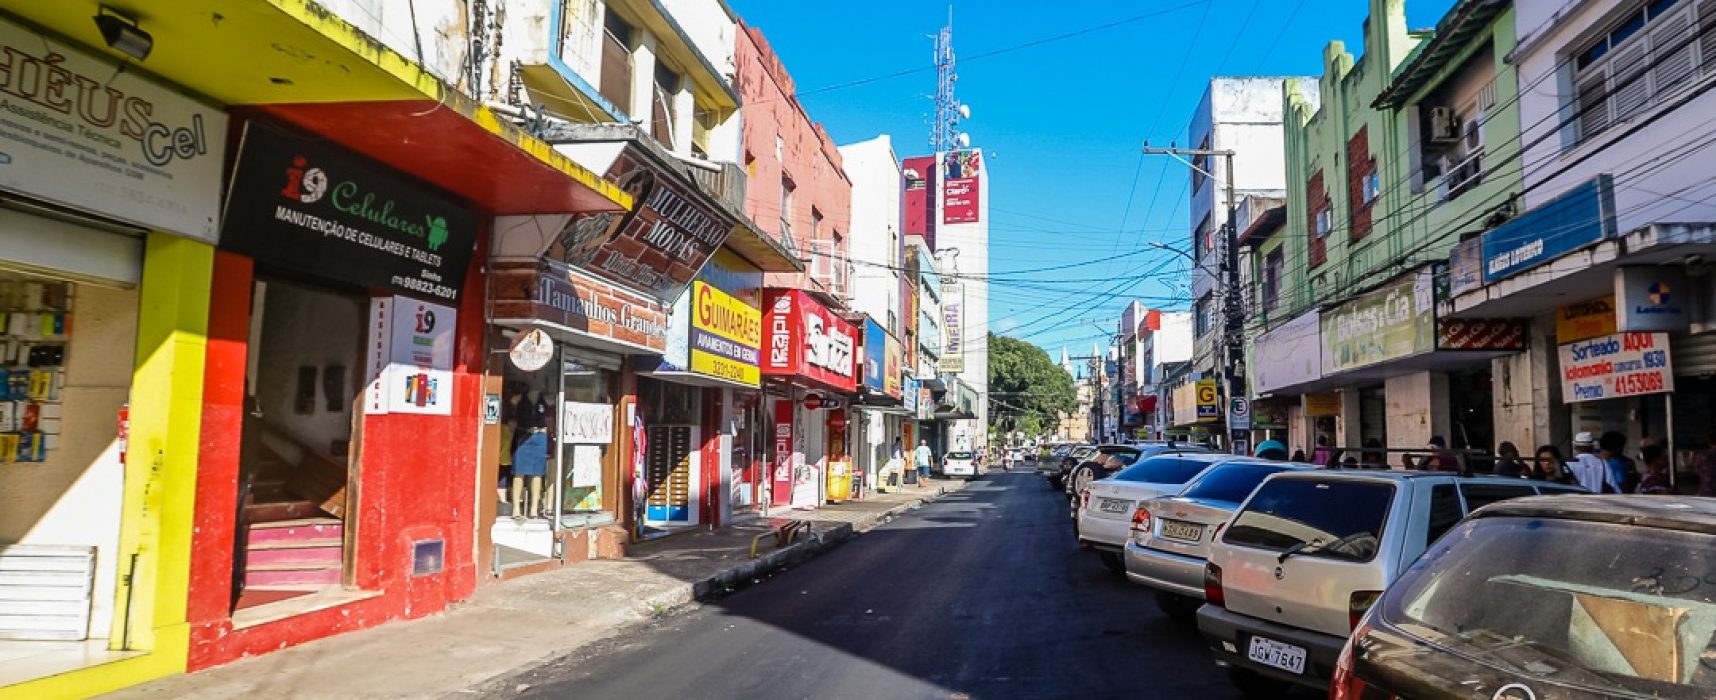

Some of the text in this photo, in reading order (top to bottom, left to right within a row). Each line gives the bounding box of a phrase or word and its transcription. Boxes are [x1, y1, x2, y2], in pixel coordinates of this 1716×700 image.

[142, 114, 207, 166] Cel
[282, 156, 424, 238] i9 Celulares
[275, 205, 442, 268] MANUTENÇÃO DE CELULARES E TABLETS
[643, 219, 700, 261] MODAS
[415, 304, 436, 334] i9
[540, 276, 666, 338] Tamanhos Grandes
[699, 285, 760, 343] GUIMARÃES
[1571, 332, 1654, 361] Sorteado AQUI
[1200, 386, 1215, 403] G
